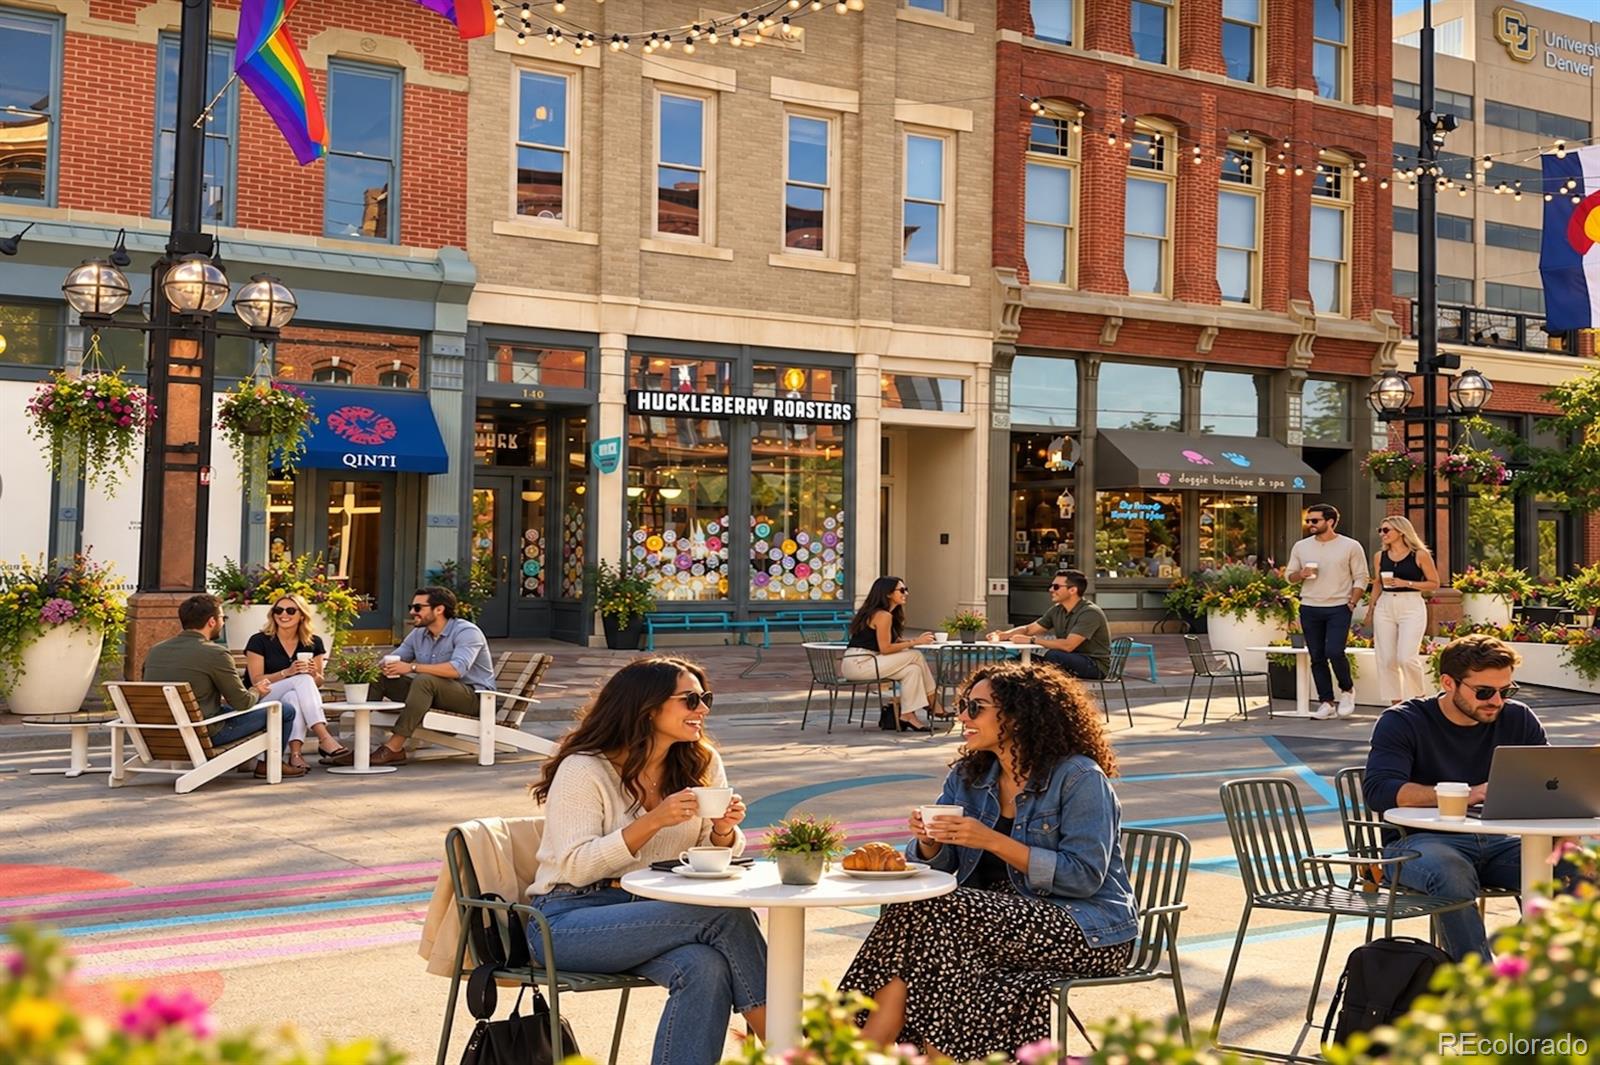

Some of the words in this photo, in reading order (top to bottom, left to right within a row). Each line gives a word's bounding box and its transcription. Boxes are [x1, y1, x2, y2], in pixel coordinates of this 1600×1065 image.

[1545, 51, 1594, 77] Denver
[522, 389, 545, 399] 140
[637, 391, 769, 416] HUCKLEBERRY
[773, 399, 852, 421] ROASTERS
[342, 453, 397, 468] QINTI
[1178, 473, 1209, 486] doggie
[1213, 475, 1254, 488] boutique
[1257, 477, 1266, 487] &
[1269, 481, 1286, 489] spa
